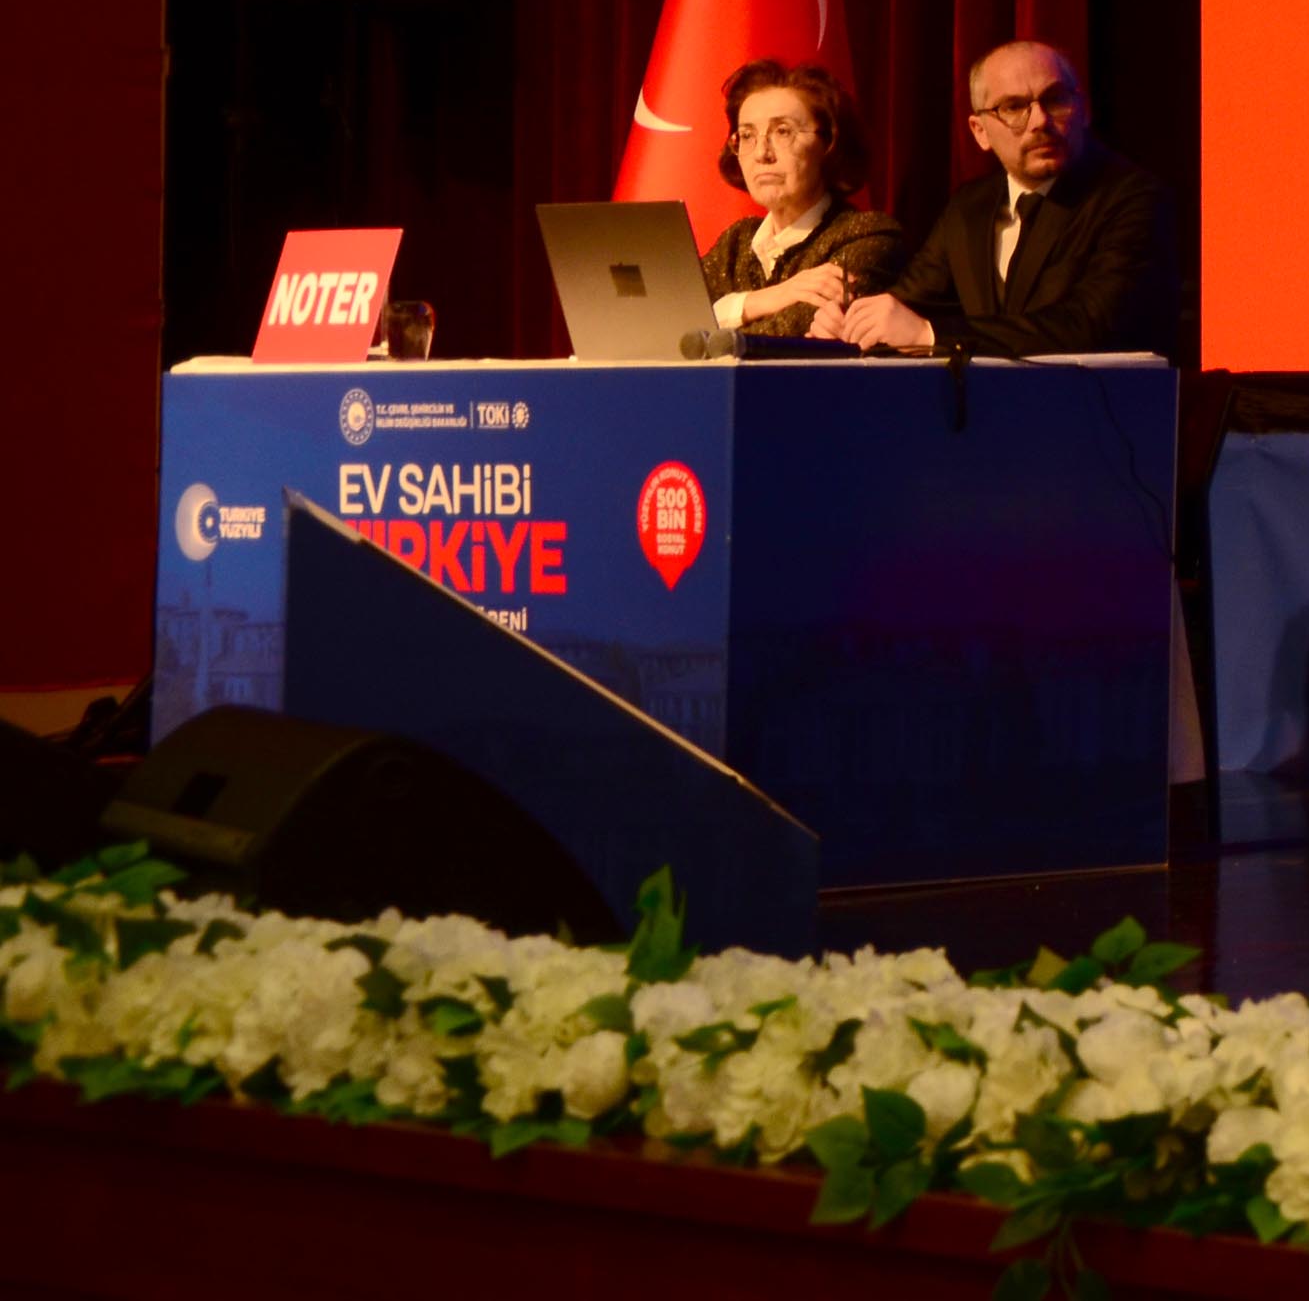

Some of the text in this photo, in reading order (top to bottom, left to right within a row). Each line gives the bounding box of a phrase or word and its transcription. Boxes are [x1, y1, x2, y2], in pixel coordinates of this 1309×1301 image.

[268, 272, 378, 326] NOTER
[339, 463, 391, 515] EV
[656, 487, 688, 509] 500
